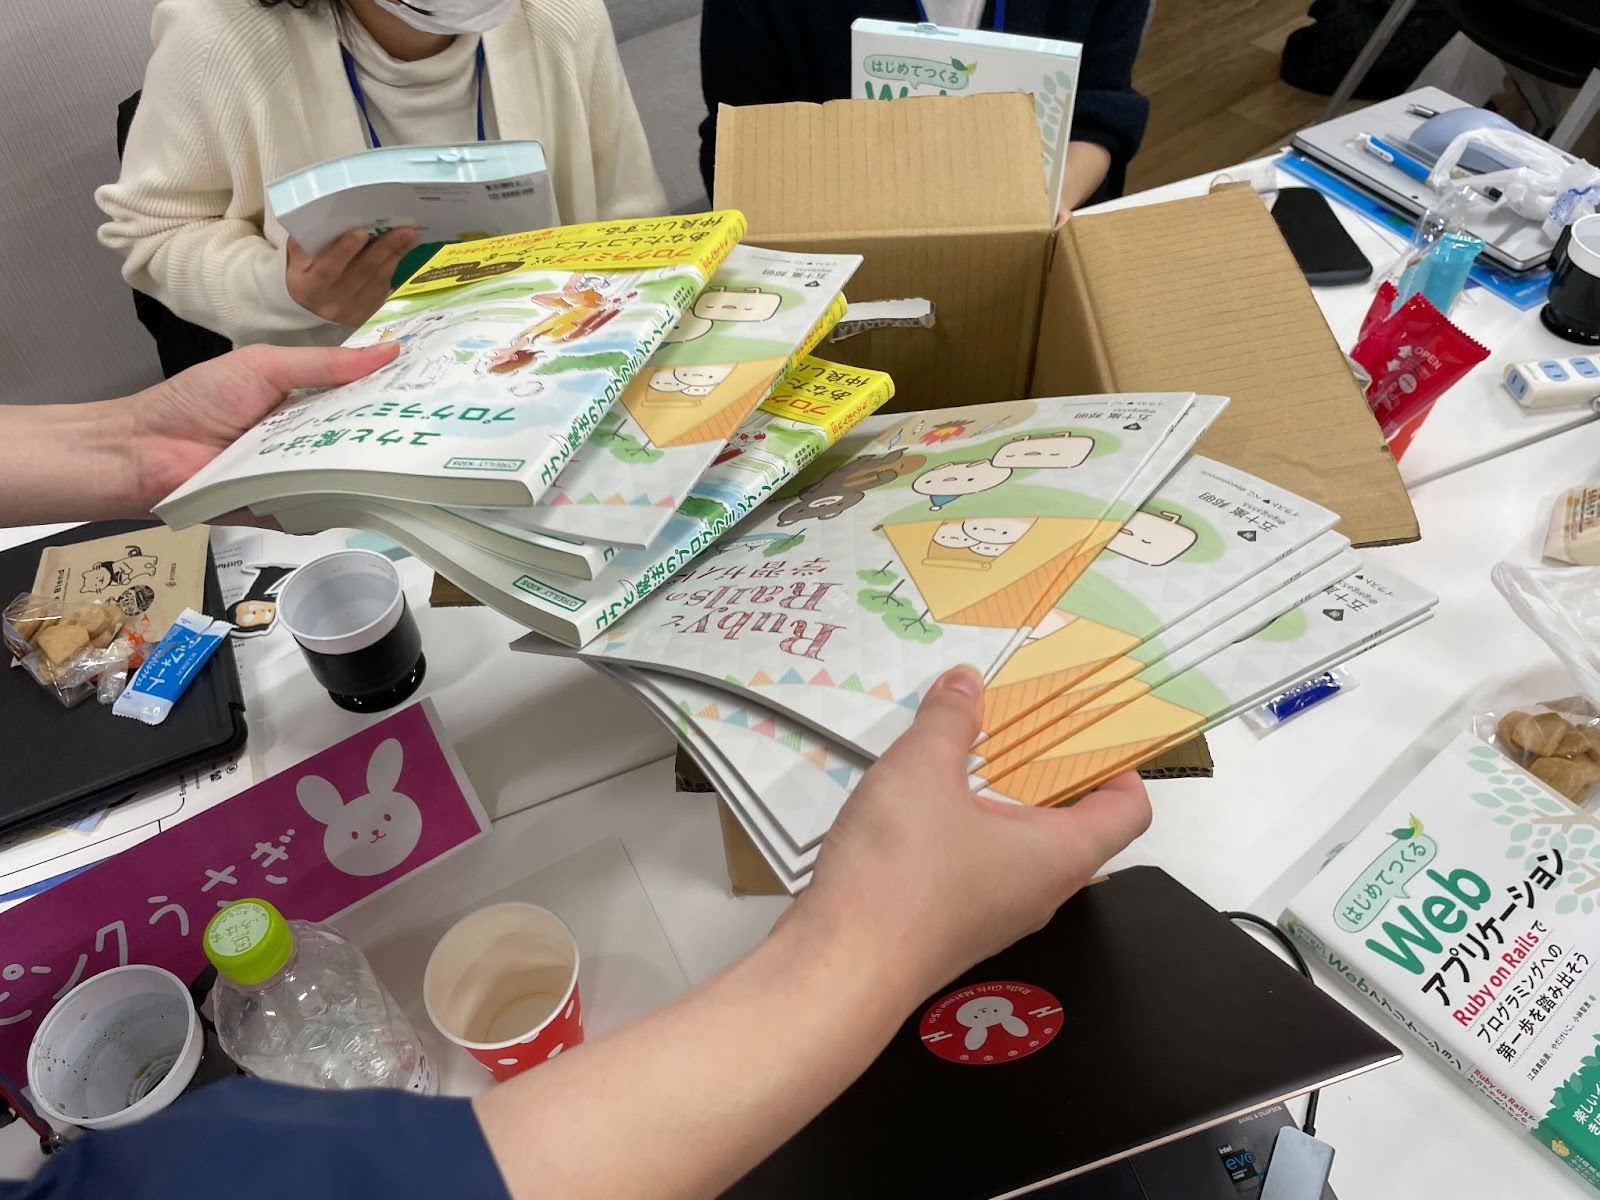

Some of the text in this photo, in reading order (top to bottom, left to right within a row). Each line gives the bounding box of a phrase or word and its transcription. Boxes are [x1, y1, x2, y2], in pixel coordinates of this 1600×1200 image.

[871, 59, 960, 85] はじめてつくる
[597, 215, 724, 235] 仲良しにする。
[1414, 345, 1441, 371] OPEN
[1229, 505, 1279, 533] 五十嵐
[53, 568, 65, 595] Blend
[663, 581, 843, 613] Railsの
[660, 607, 848, 662] Rubyと
[146, 634, 202, 693] アルフォート
[1341, 841, 1428, 926] はじめてつくる
[1365, 868, 1492, 976] Web
[1421, 848, 1564, 1007] アプリケーション
[1500, 920, 1548, 969] Railsで
[976, 983, 1004, 992] Girls
[1005, 984, 1032, 995] Rails
[1490, 966, 1511, 988] on
[1452, 984, 1497, 1027] Ruby
[1476, 943, 1563, 1044] プログラミングへの
[1495, 951, 1590, 1063] 第一歩を踏み出そう
[1473, 1068, 1496, 1089] Ruby
[1496, 1087, 1508, 1099] on
[1218, 1144, 1233, 1155] intel
[1225, 1150, 1257, 1171] evo
